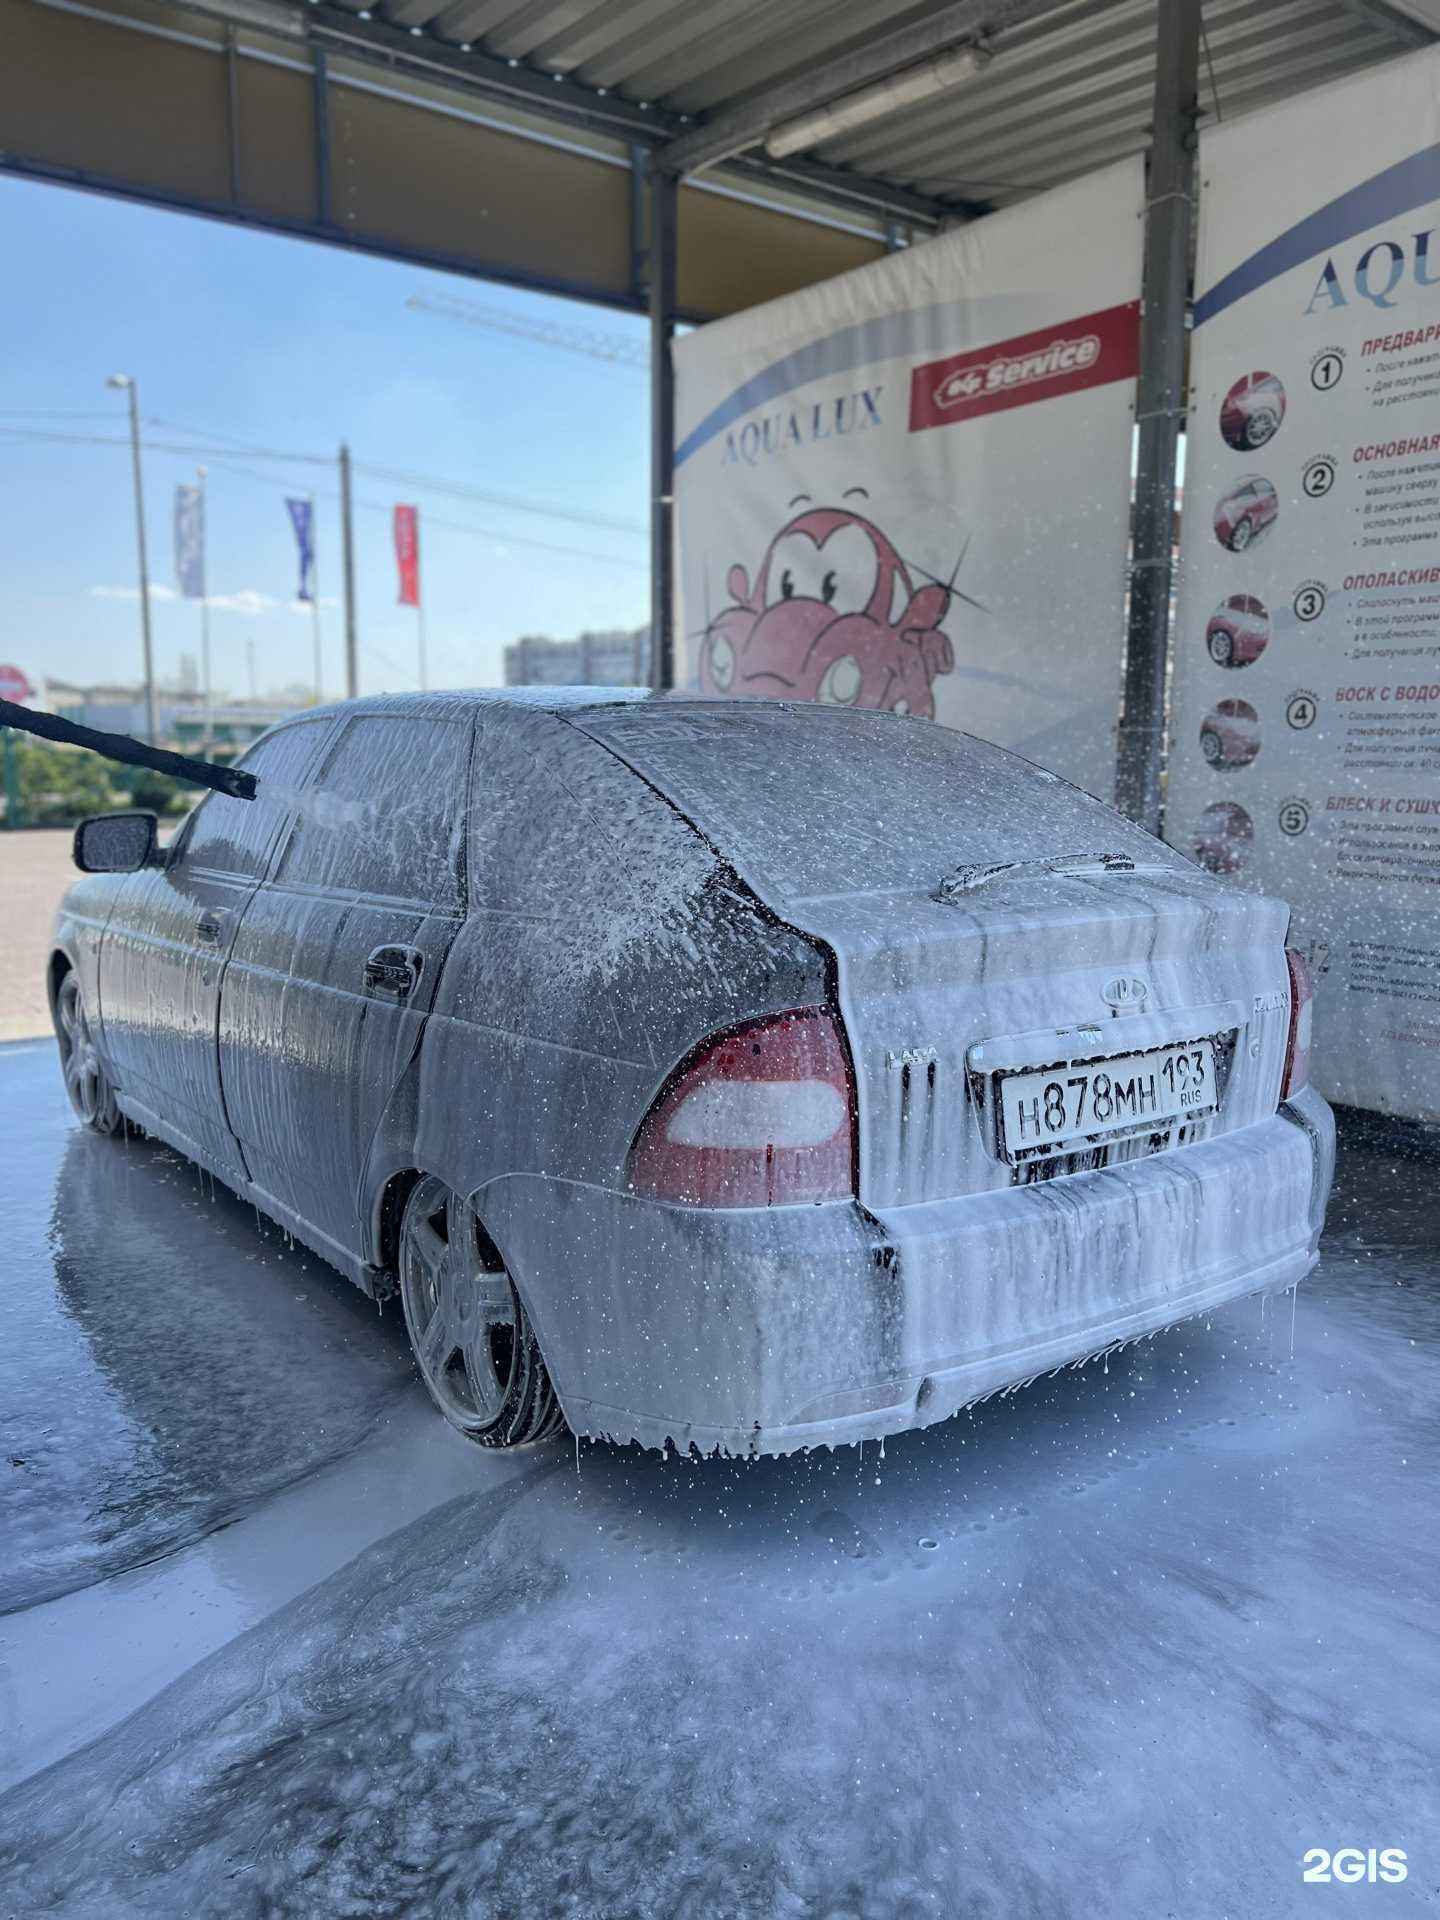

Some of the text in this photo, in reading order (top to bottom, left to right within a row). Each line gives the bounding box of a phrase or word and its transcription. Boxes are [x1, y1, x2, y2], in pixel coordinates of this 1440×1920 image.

[986, 340, 1096, 390] Service
[1321, 362, 1331, 384] 1
[1312, 468, 1327, 491] 2
[1302, 594, 1316, 615] 3
[1380, 686, 1391, 701] С
[1294, 704, 1308, 721] 4
[1286, 811, 1300, 830] 5
[1162, 1050, 1205, 1093] 193
[1018, 1072, 1157, 1140] Н878МН
[1180, 1089, 1201, 1107] RUS
